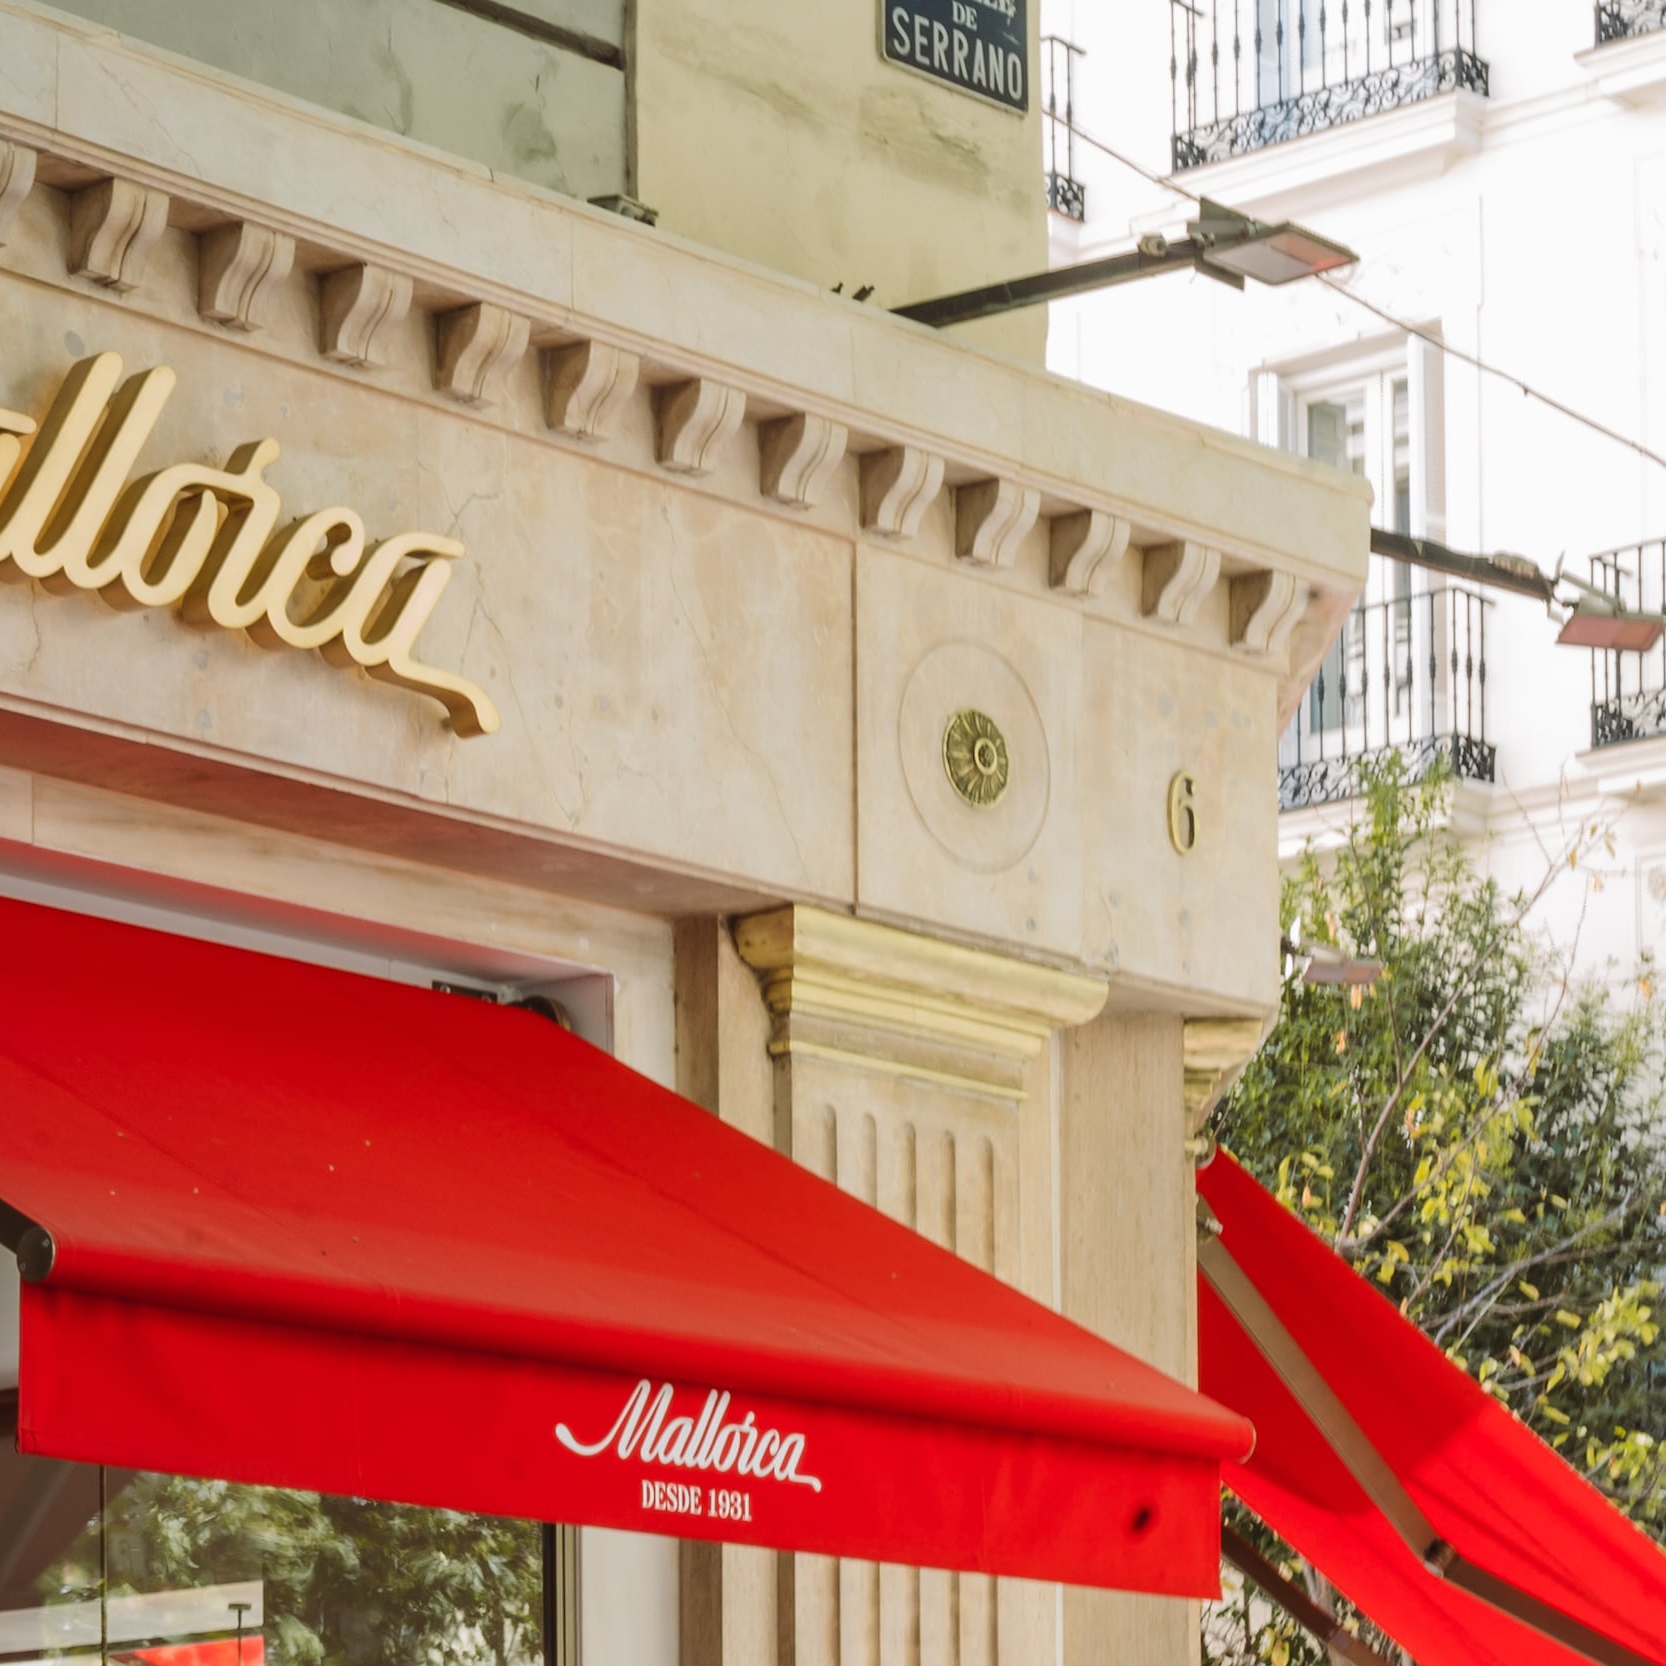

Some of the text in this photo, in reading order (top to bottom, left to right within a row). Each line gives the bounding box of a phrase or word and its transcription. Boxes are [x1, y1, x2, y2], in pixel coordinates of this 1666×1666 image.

[892, 6, 1023, 100] SERRANO
[952, 1, 978, 31] DE
[1167, 769, 1200, 857] 6
[555, 1379, 822, 1493] Mallorca
[642, 1480, 753, 1522] DESDE 1931
